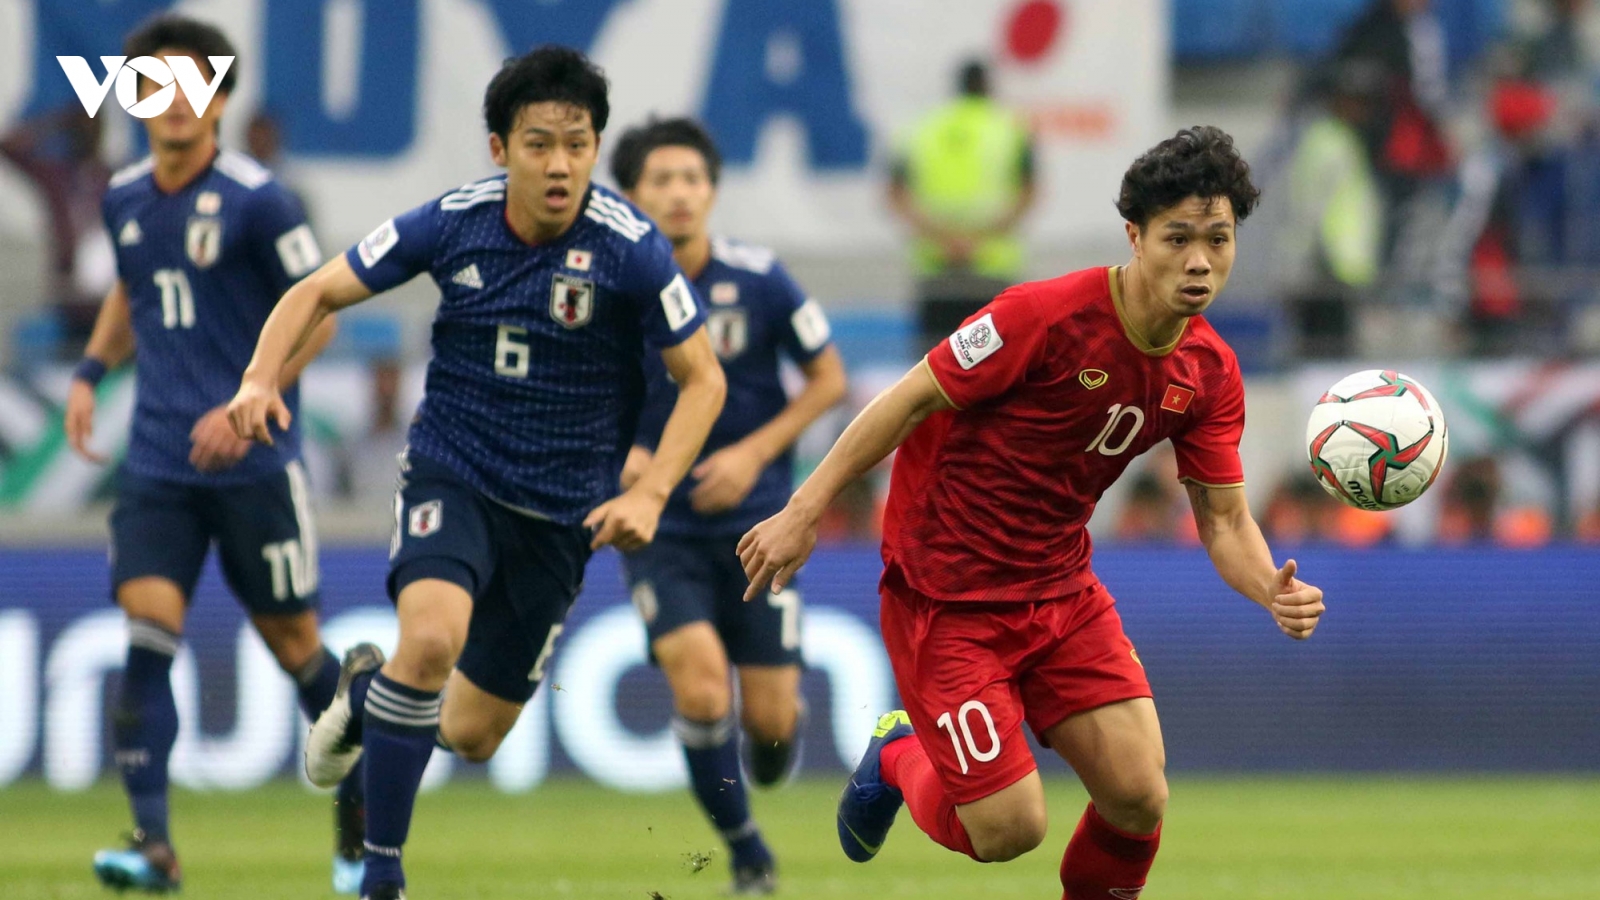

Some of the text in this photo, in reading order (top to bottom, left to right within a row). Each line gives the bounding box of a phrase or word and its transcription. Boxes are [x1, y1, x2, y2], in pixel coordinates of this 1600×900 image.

[153, 269, 196, 328] 11
[494, 324, 530, 378] 6
[1085, 403, 1145, 456] 10
[937, 700, 1000, 775] 10
